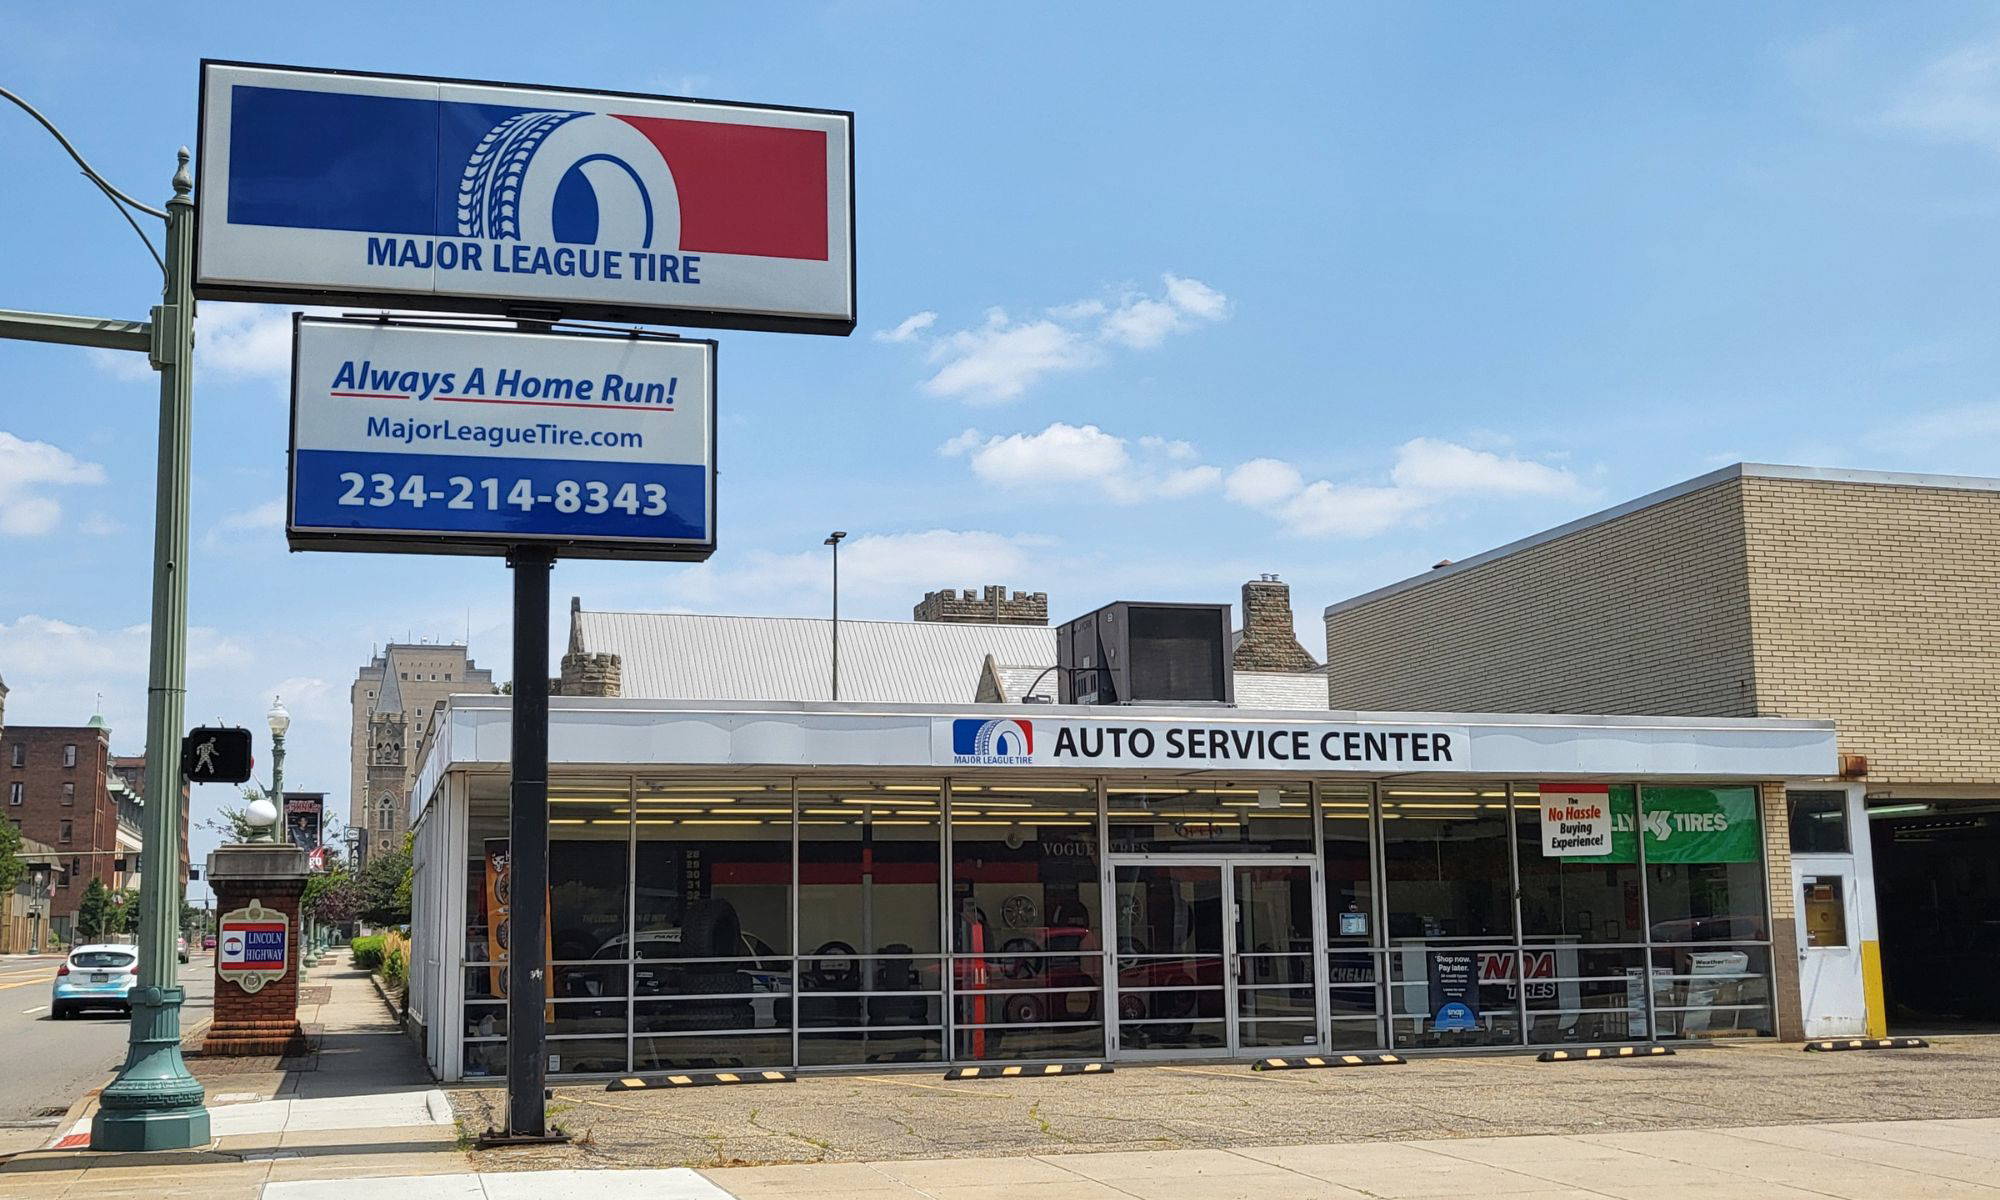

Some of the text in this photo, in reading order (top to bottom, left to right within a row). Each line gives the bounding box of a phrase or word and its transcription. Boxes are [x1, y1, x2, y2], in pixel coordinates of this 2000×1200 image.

[367, 237, 701, 284] MAJOR LEAGUE TIRE
[332, 360, 678, 405] Always A Home Run!
[366, 416, 644, 449] MajorLeagueTire.com
[337, 471, 669, 516] 234-214-8343
[1053, 726, 1454, 763] AUTO SERVICE CENTER
[953, 755, 1033, 764] MAJOR LEAGUE TIRE
[1567, 796, 1579, 804] The
[1548, 804, 1601, 821] No Hassle
[1560, 822, 1592, 836] Buying
[1673, 812, 1728, 832] TIRES
[1043, 843, 1096, 856] VOGUE
[1551, 834, 1603, 851] Experience!
[248, 932, 282, 944] LINCOLN
[246, 949, 283, 961] HIGHWAY
[1330, 967, 1377, 982] CHELIN
[1438, 964, 1470, 973] Pay later.
[1477, 952, 1556, 980] ENDA
[1506, 983, 1556, 1000] TRES
